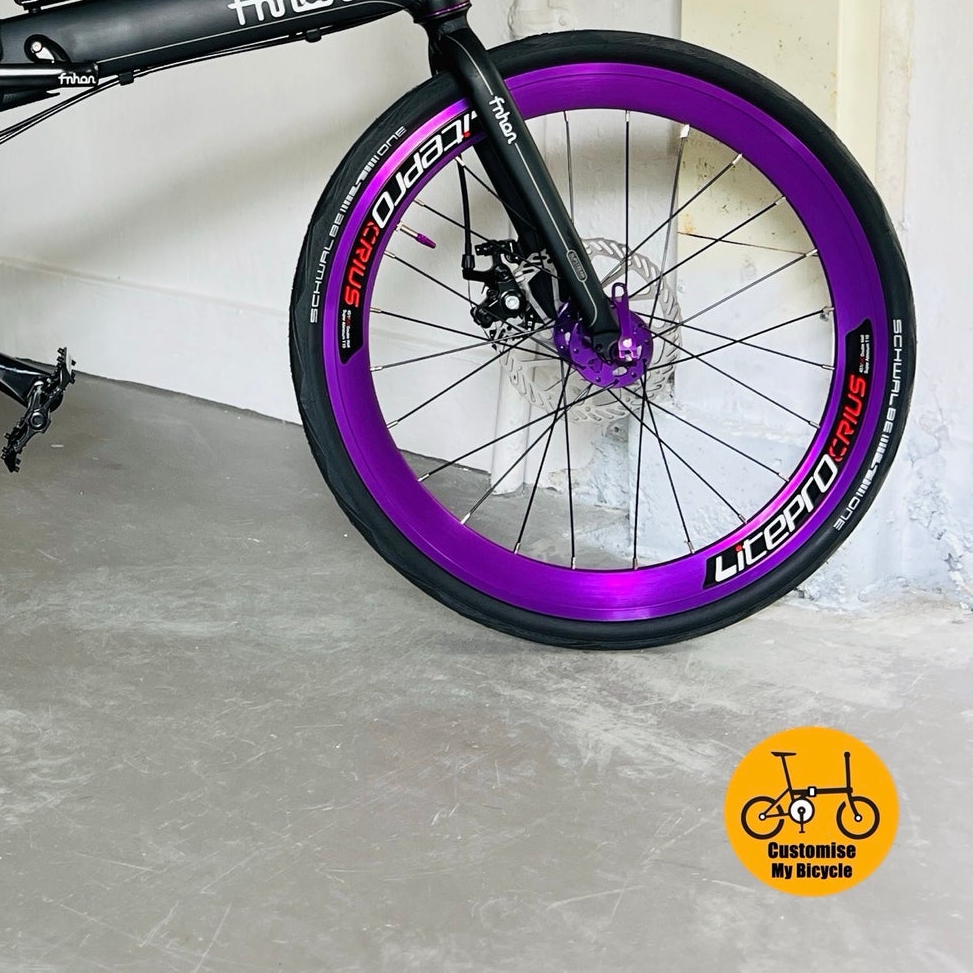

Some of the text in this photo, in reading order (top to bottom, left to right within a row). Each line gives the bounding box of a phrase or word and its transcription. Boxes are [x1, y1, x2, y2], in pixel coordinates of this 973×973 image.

[58, 72, 97, 86] fnhon
[489, 96, 518, 146] fnhon
[344, 110, 478, 308] itepro CRIUS
[310, 213, 345, 324] SCHWALBE
[828, 374, 867, 463] CRIUS
[885, 318, 903, 435] SCHWALBE
